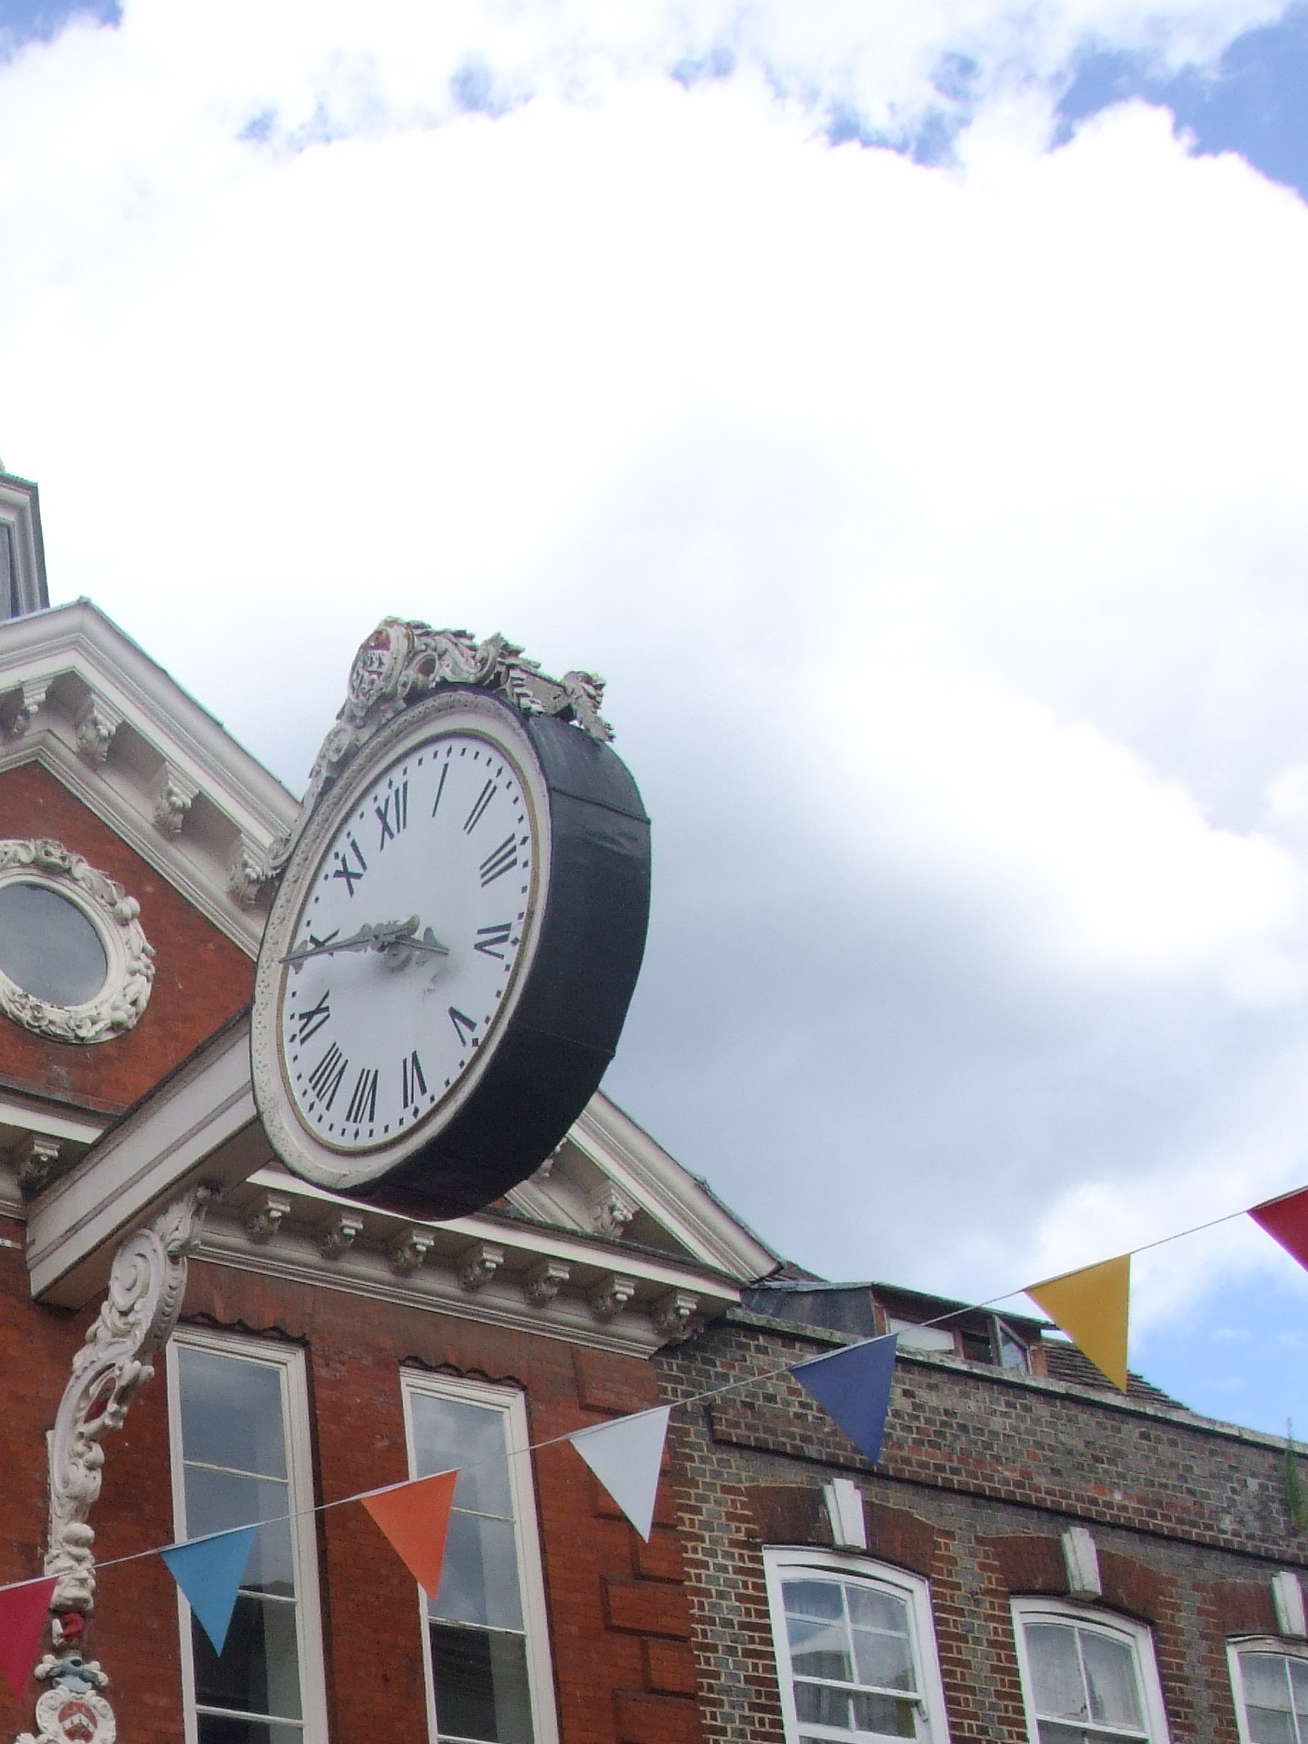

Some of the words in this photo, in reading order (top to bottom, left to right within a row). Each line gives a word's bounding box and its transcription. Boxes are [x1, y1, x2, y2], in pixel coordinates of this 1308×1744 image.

[375, 780, 409, 852] XII
[333, 838, 367, 899] XI
[479, 832, 518, 888] III
